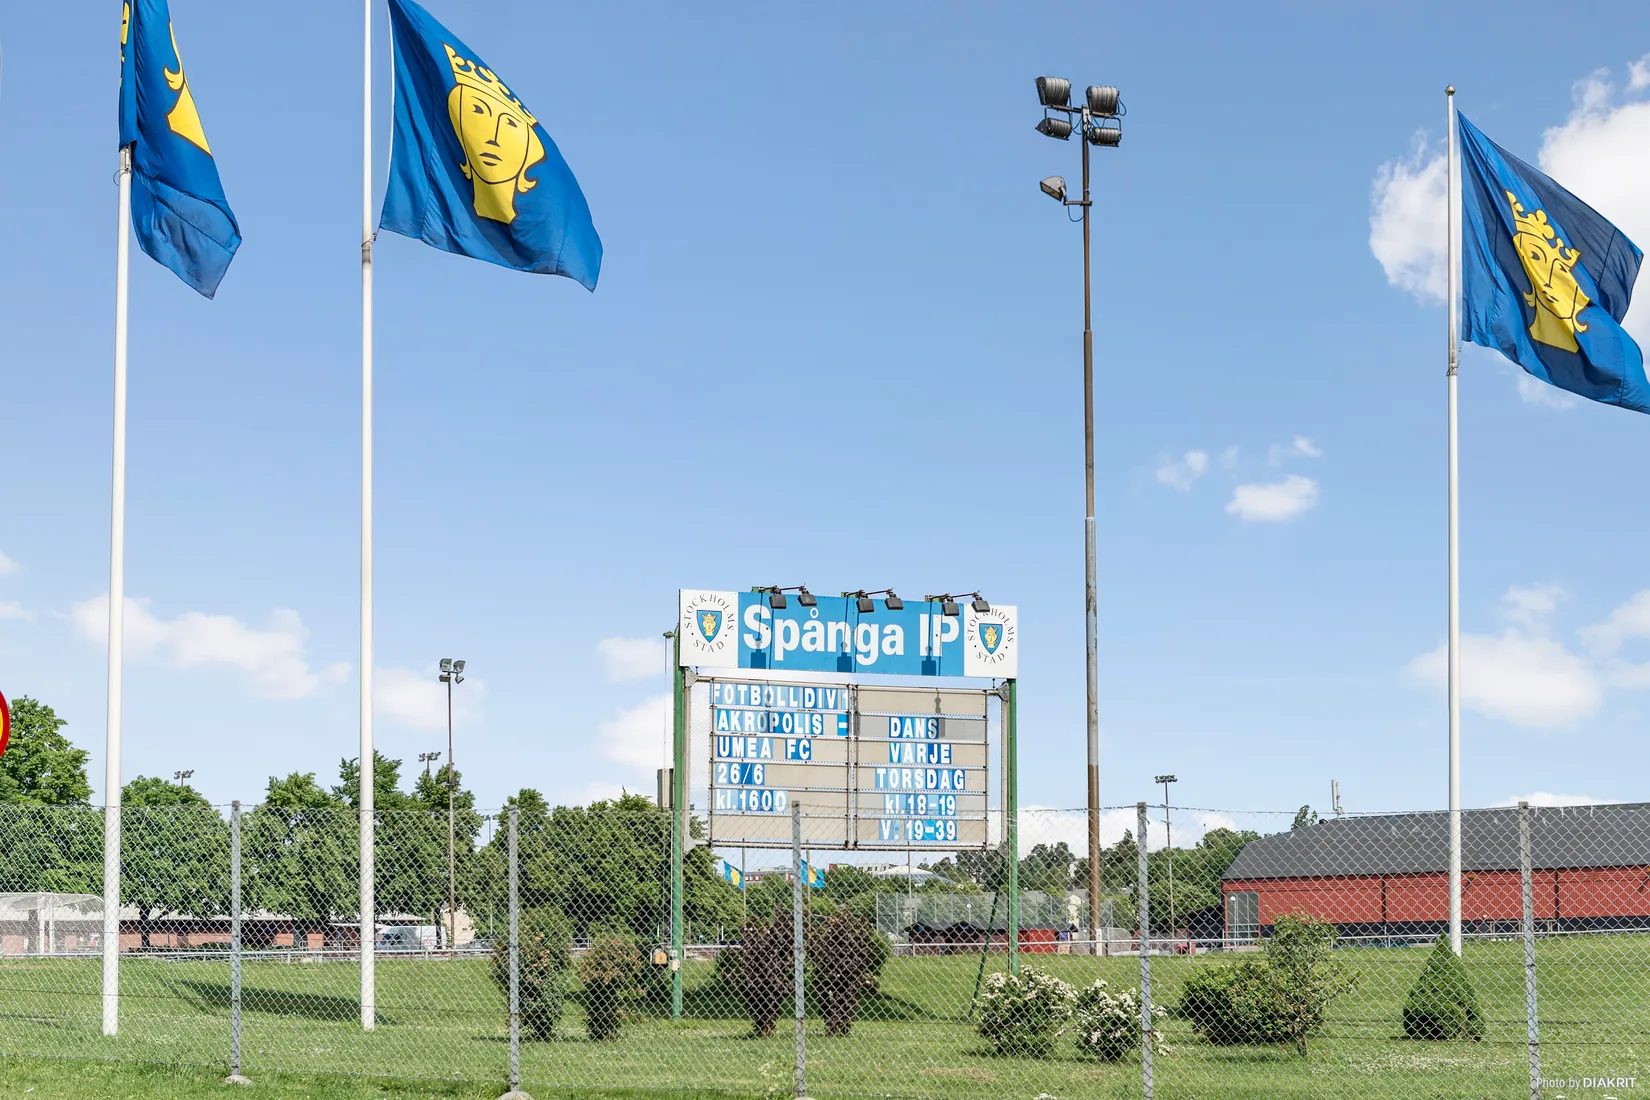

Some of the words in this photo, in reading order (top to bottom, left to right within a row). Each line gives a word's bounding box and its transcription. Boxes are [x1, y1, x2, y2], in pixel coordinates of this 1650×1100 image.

[684, 594, 735, 631] STOCKHOLMS
[693, 639, 724, 653] STAD
[743, 604, 905, 666] Spånga
[919, 613, 960, 657] IP
[976, 651, 1005, 664] STAD
[713, 683, 798, 707] FOTBOLL
[804, 687, 837, 709] DIV
[718, 709, 823, 735] AKROPOLIS
[890, 717, 938, 739] DANS
[719, 736, 773, 759] UMEA
[786, 738, 811, 760] FC
[890, 742, 951, 764] VARJE
[717, 763, 764, 785] 26/6
[876, 768, 965, 790] TORSDAG
[905, 820, 956, 841] 19-39
